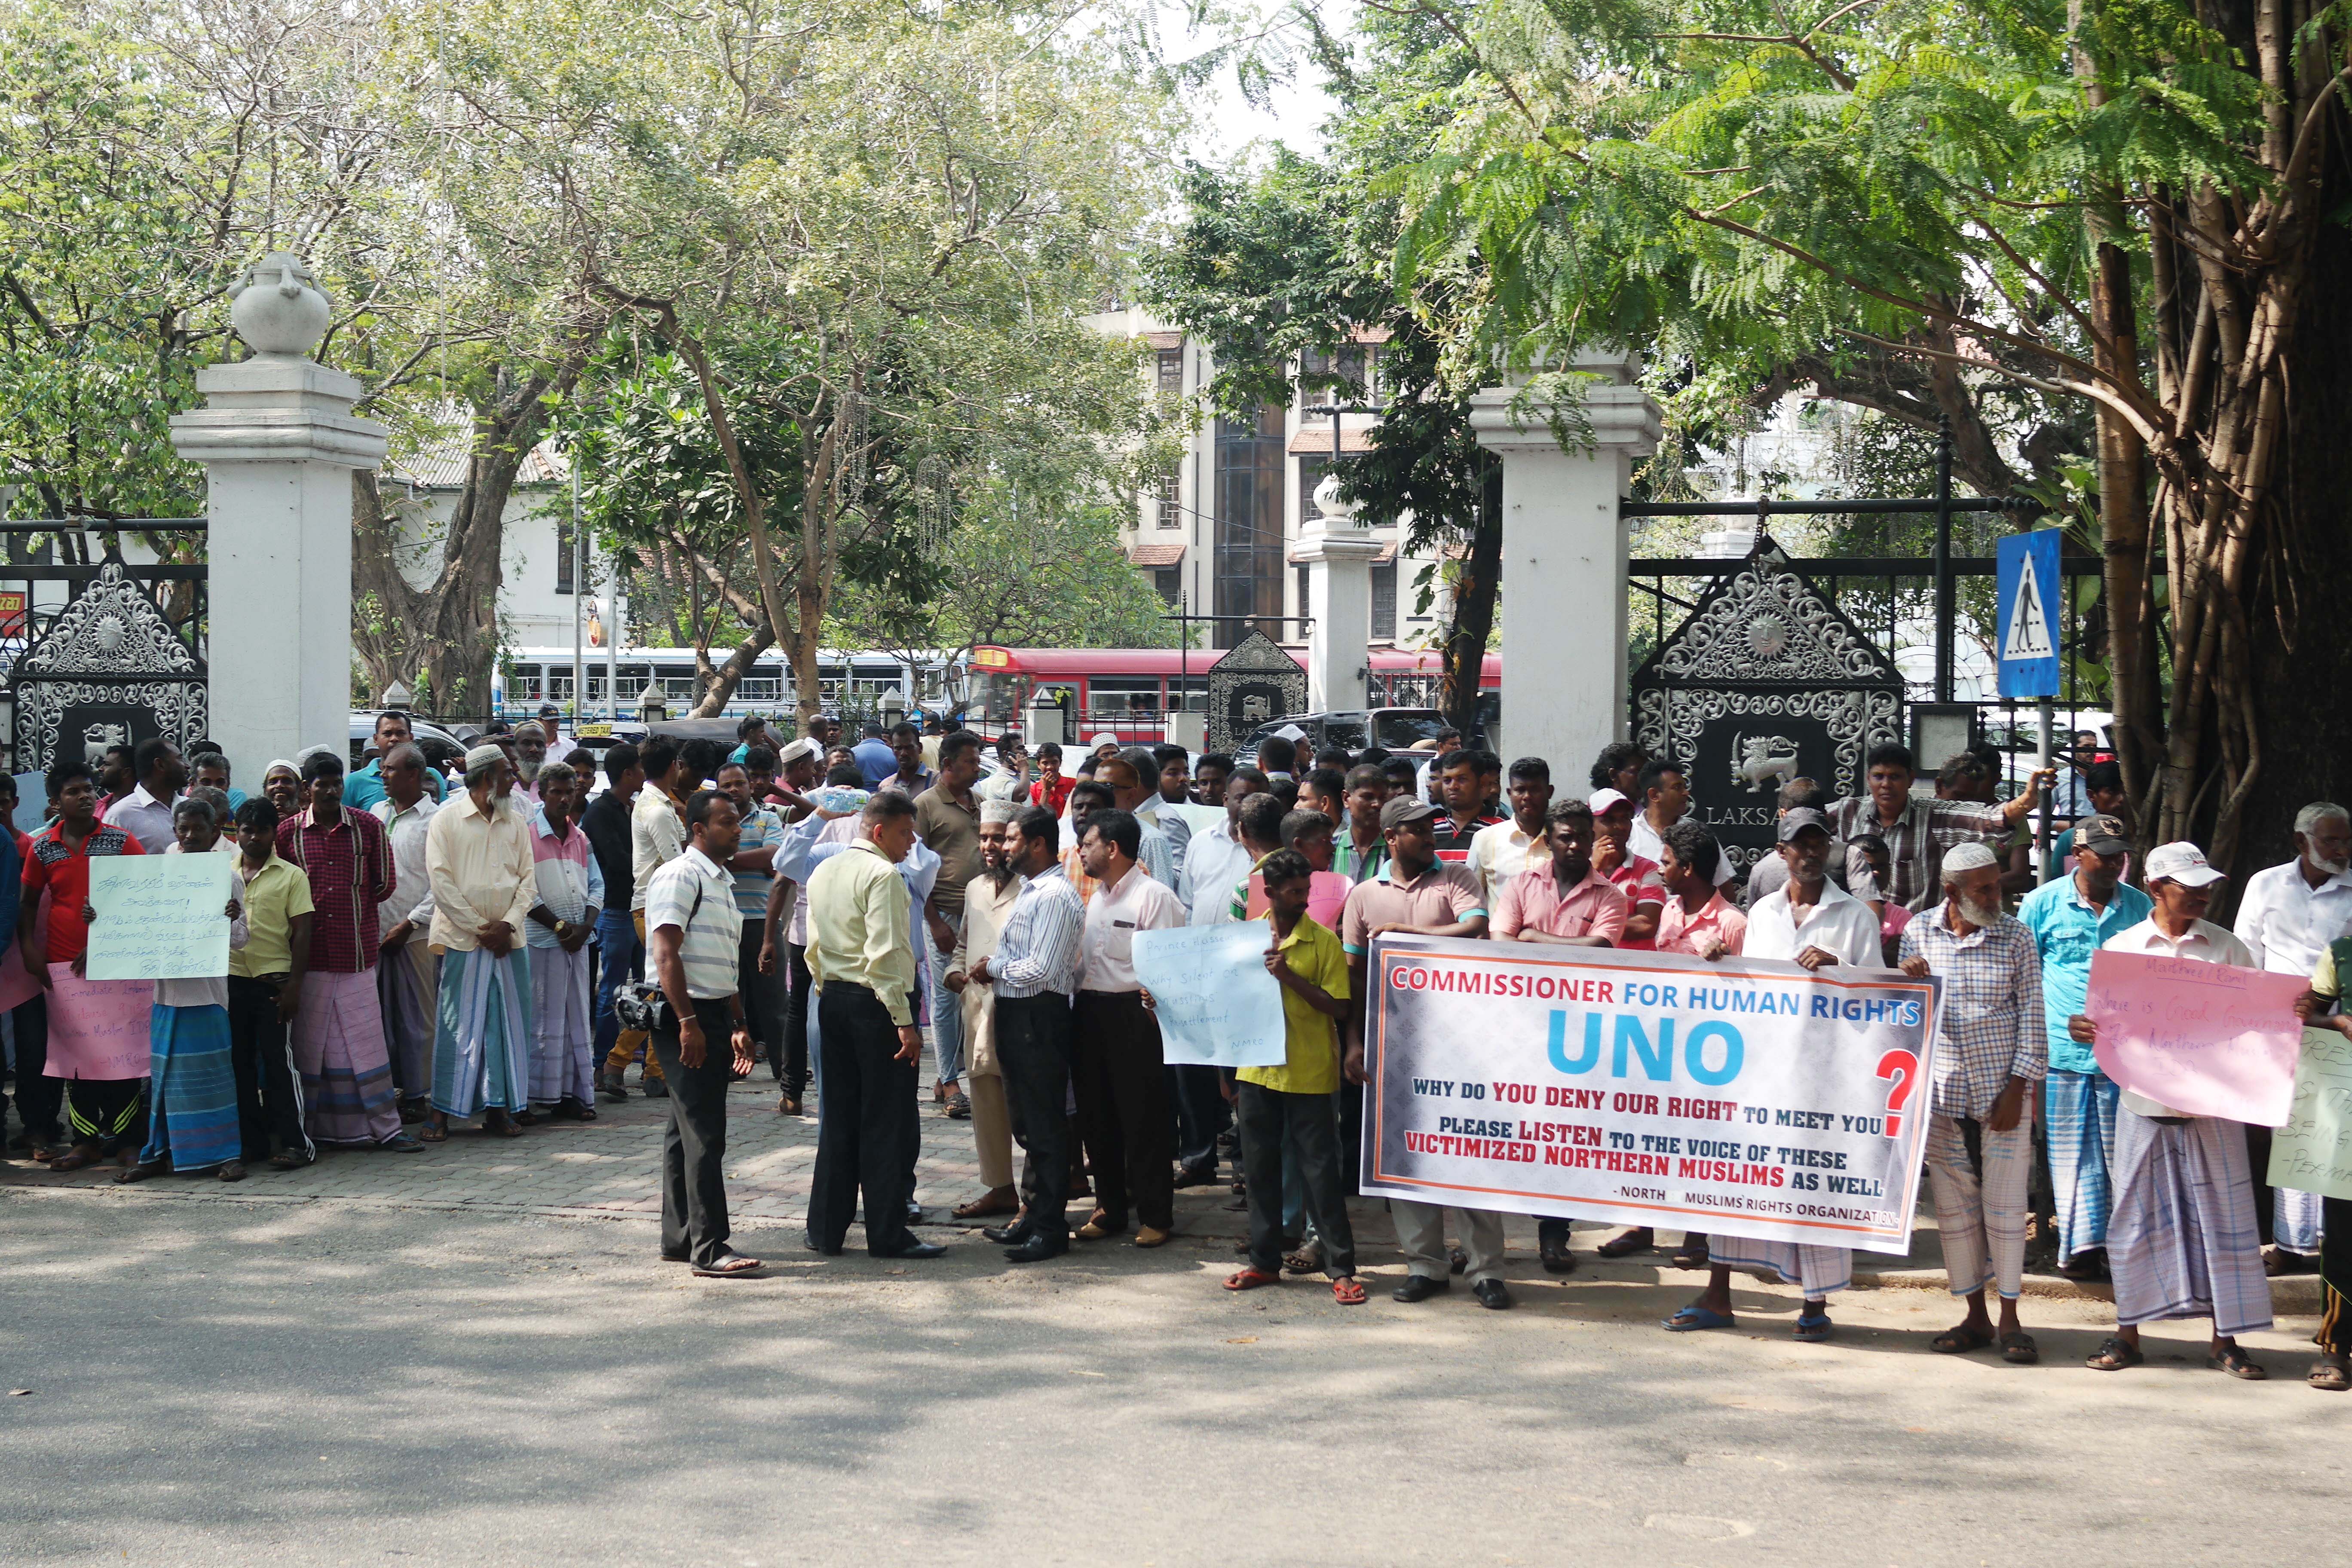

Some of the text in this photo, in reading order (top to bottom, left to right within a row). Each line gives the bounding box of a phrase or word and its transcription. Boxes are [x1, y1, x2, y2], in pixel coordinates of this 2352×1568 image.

[1145, 940, 1187, 956] Prince
[1146, 973, 1172, 988] Why
[1180, 967, 1213, 984] Silent
[1391, 966, 1921, 1026] COMMISSIONER FOR HUMAN RIGHTS
[1230, 1038, 1264, 1050] NMRO
[1547, 1009, 1745, 1085] UNO
[1412, 1078, 1455, 1097] WHY
[1461, 1082, 1485, 1100] DO
[1492, 1082, 1537, 1105] YOU
[1545, 1086, 1605, 1110] DENY
[1613, 1092, 1659, 1115] OUR
[1667, 1096, 1738, 1121] RIGHT
[1743, 1106, 1768, 1125] TO
[1775, 1109, 1834, 1130] MEET
[1841, 1115, 1882, 1135] YOU
[1405, 1130, 1884, 1197] VICTIMIZED NORTHERN MUSLIMS AS WELL
[1439, 1116, 1847, 1170] PLEASE LISTEN TO THE VOICE OF THESE
[1621, 1185, 1666, 1200] NORTH
[1746, 1198, 1792, 1213] RIGHTS
